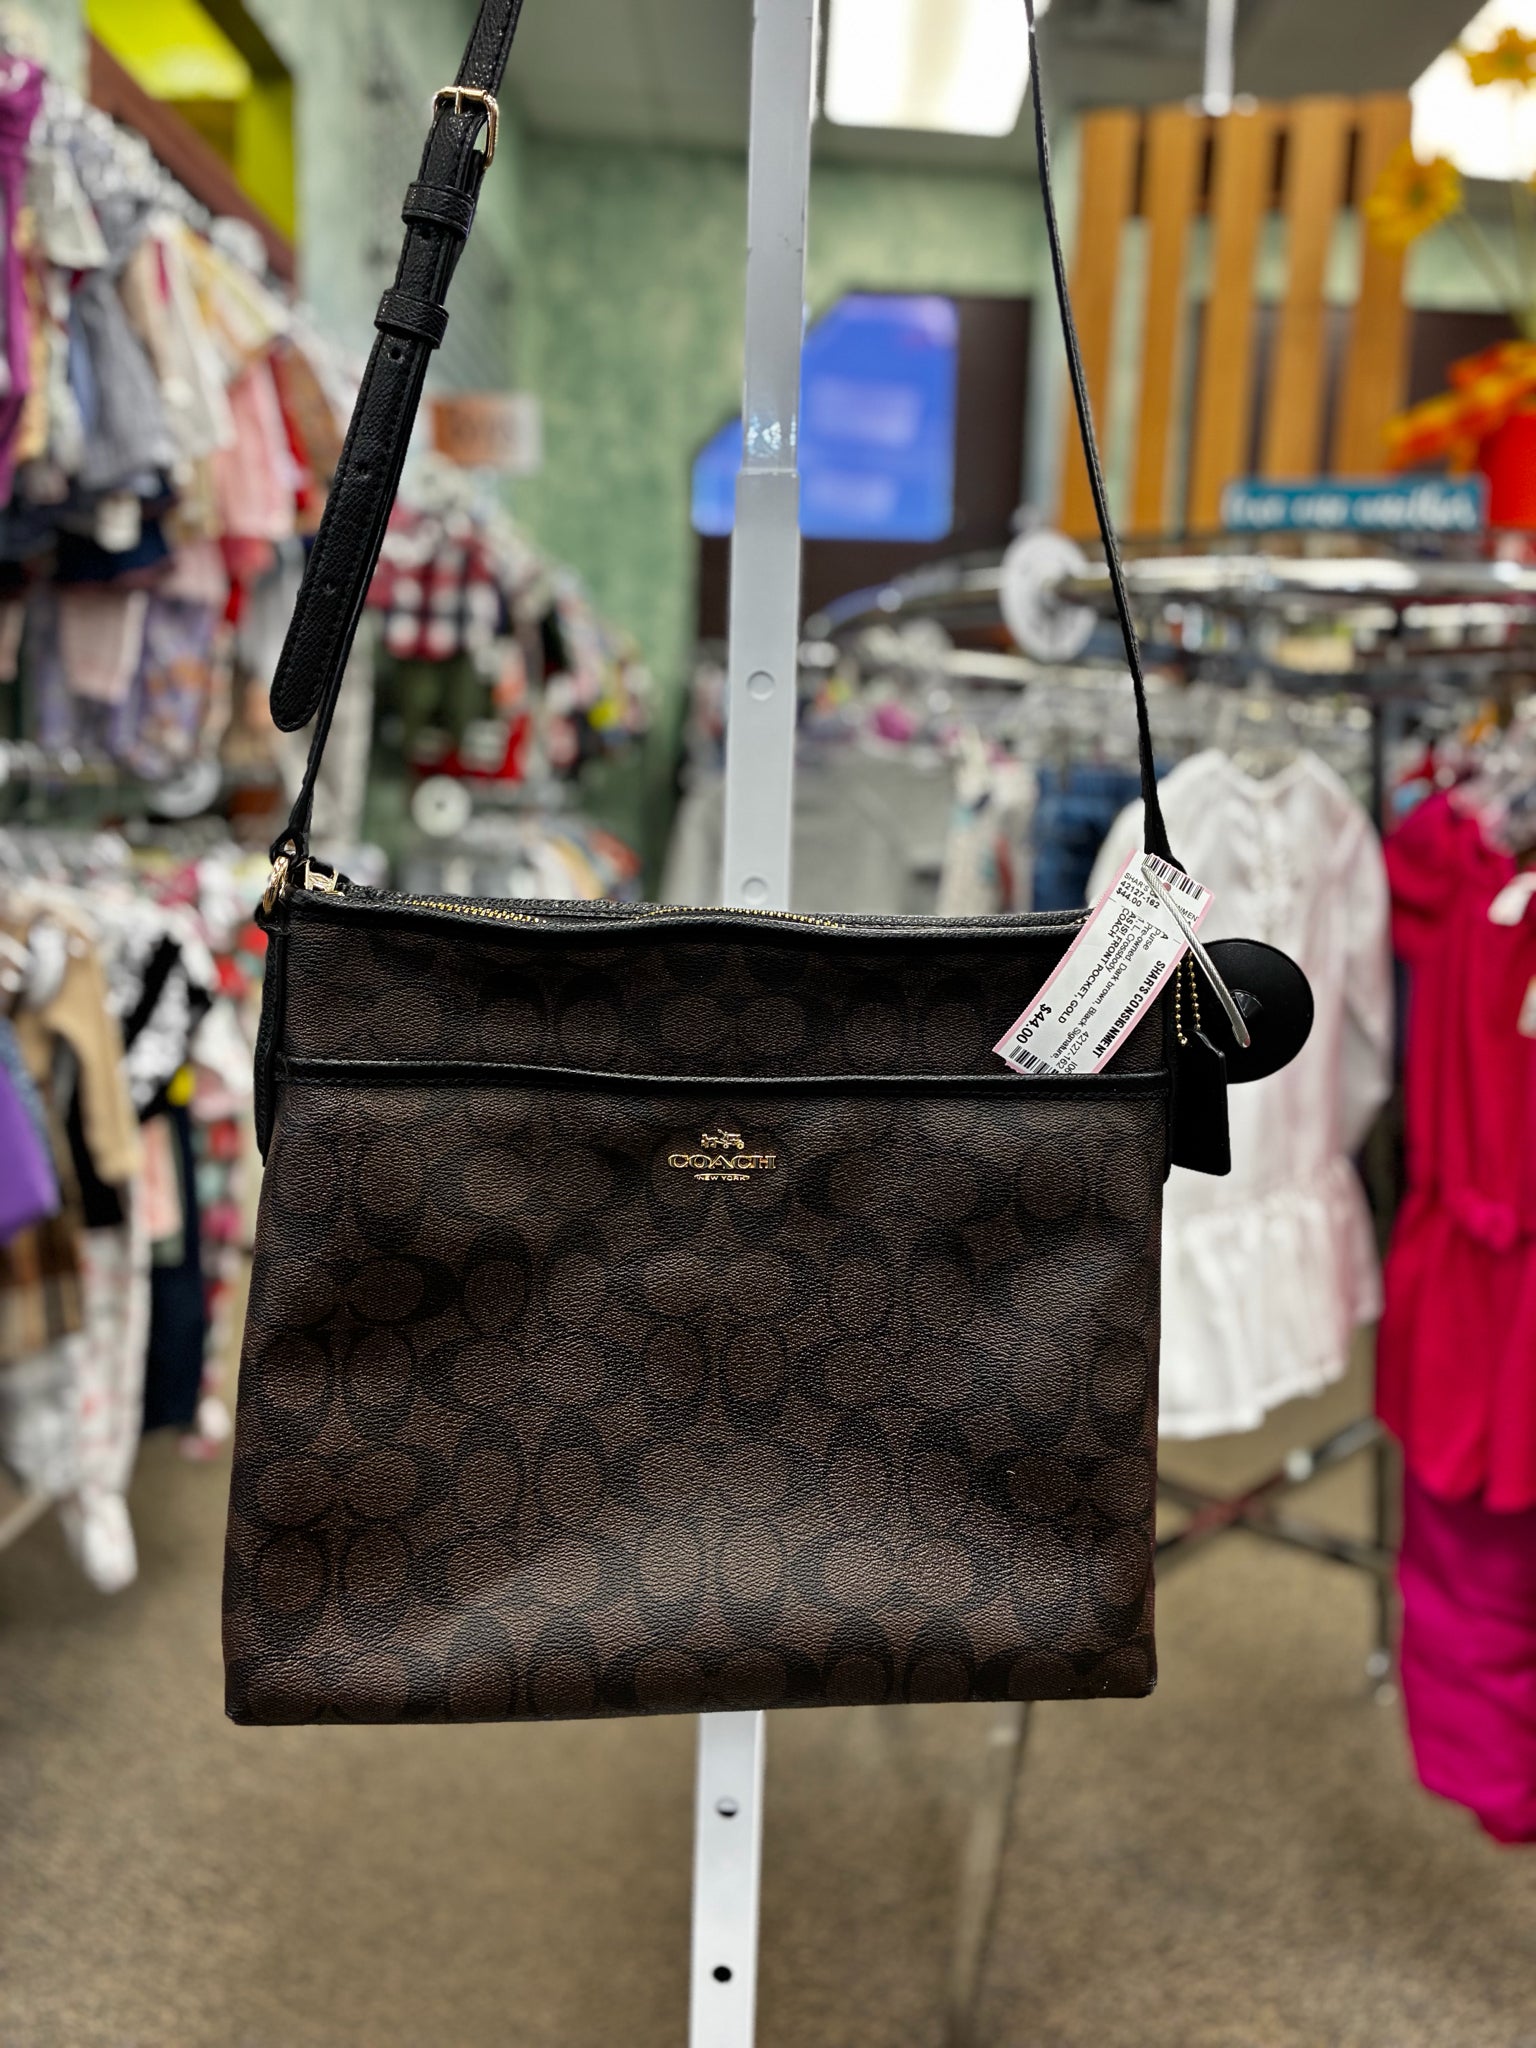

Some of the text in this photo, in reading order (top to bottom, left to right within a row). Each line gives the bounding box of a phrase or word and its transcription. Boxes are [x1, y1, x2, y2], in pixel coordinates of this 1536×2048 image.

[1114, 886, 1142, 907] $44.00
[1119, 879, 1160, 909] 42127-162
[1123, 872, 1149, 892] SHAR'S
[1107, 906, 1130, 938] COACH
[1141, 926, 1161, 951] Purse
[1056, 911, 1137, 1024] AS IS! FRONT POCKET, GOLD
[1103, 931, 1135, 972] Crossbody
[1049, 921, 1153, 1061] Pre-owned, Dark brown, Black Signature,
[1091, 959, 1166, 1058] SHAR'S CONSIGNMENT
[1015, 1002, 1052, 1045] $44.00
[1055, 1029, 1090, 1070] 42127-162
[668, 1154, 776, 1169] COACH
